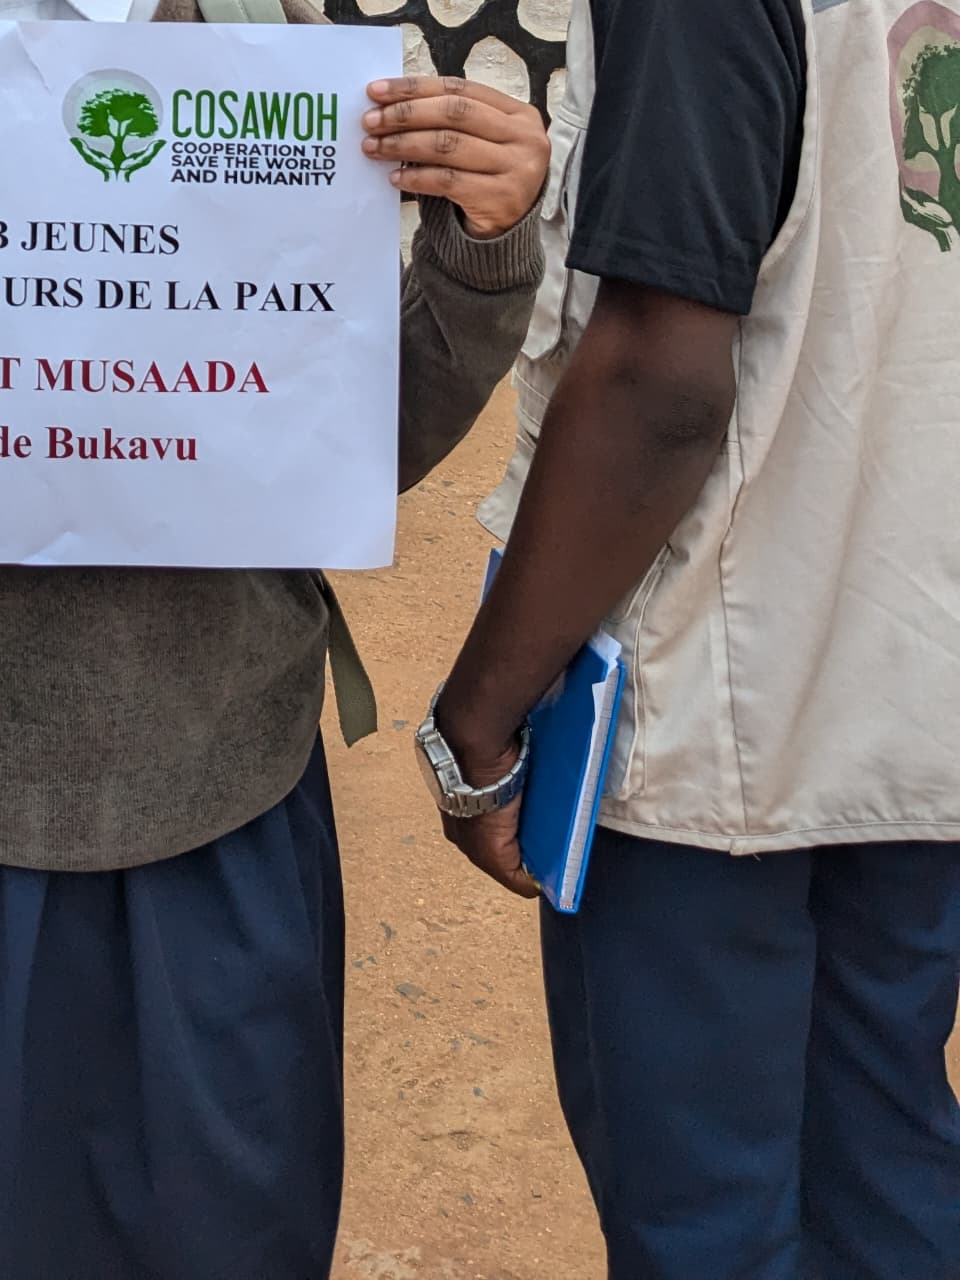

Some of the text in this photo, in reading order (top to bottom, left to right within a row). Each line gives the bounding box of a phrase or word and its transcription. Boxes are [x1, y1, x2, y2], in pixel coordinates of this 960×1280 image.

[172, 88, 338, 142] COSAWOH
[171, 141, 336, 158] COOPERATION TO
[171, 154, 336, 171] SAVE THE WORLD
[170, 169, 337, 186] AND HUMANITY
[20, 221, 180, 255] JEUNES
[96, 279, 152, 310] DE
[164, 281, 222, 310] LA
[233, 281, 336, 312] PAIX
[33, 358, 270, 393] MUSAADA
[44, 426, 198, 461] Bukavu
